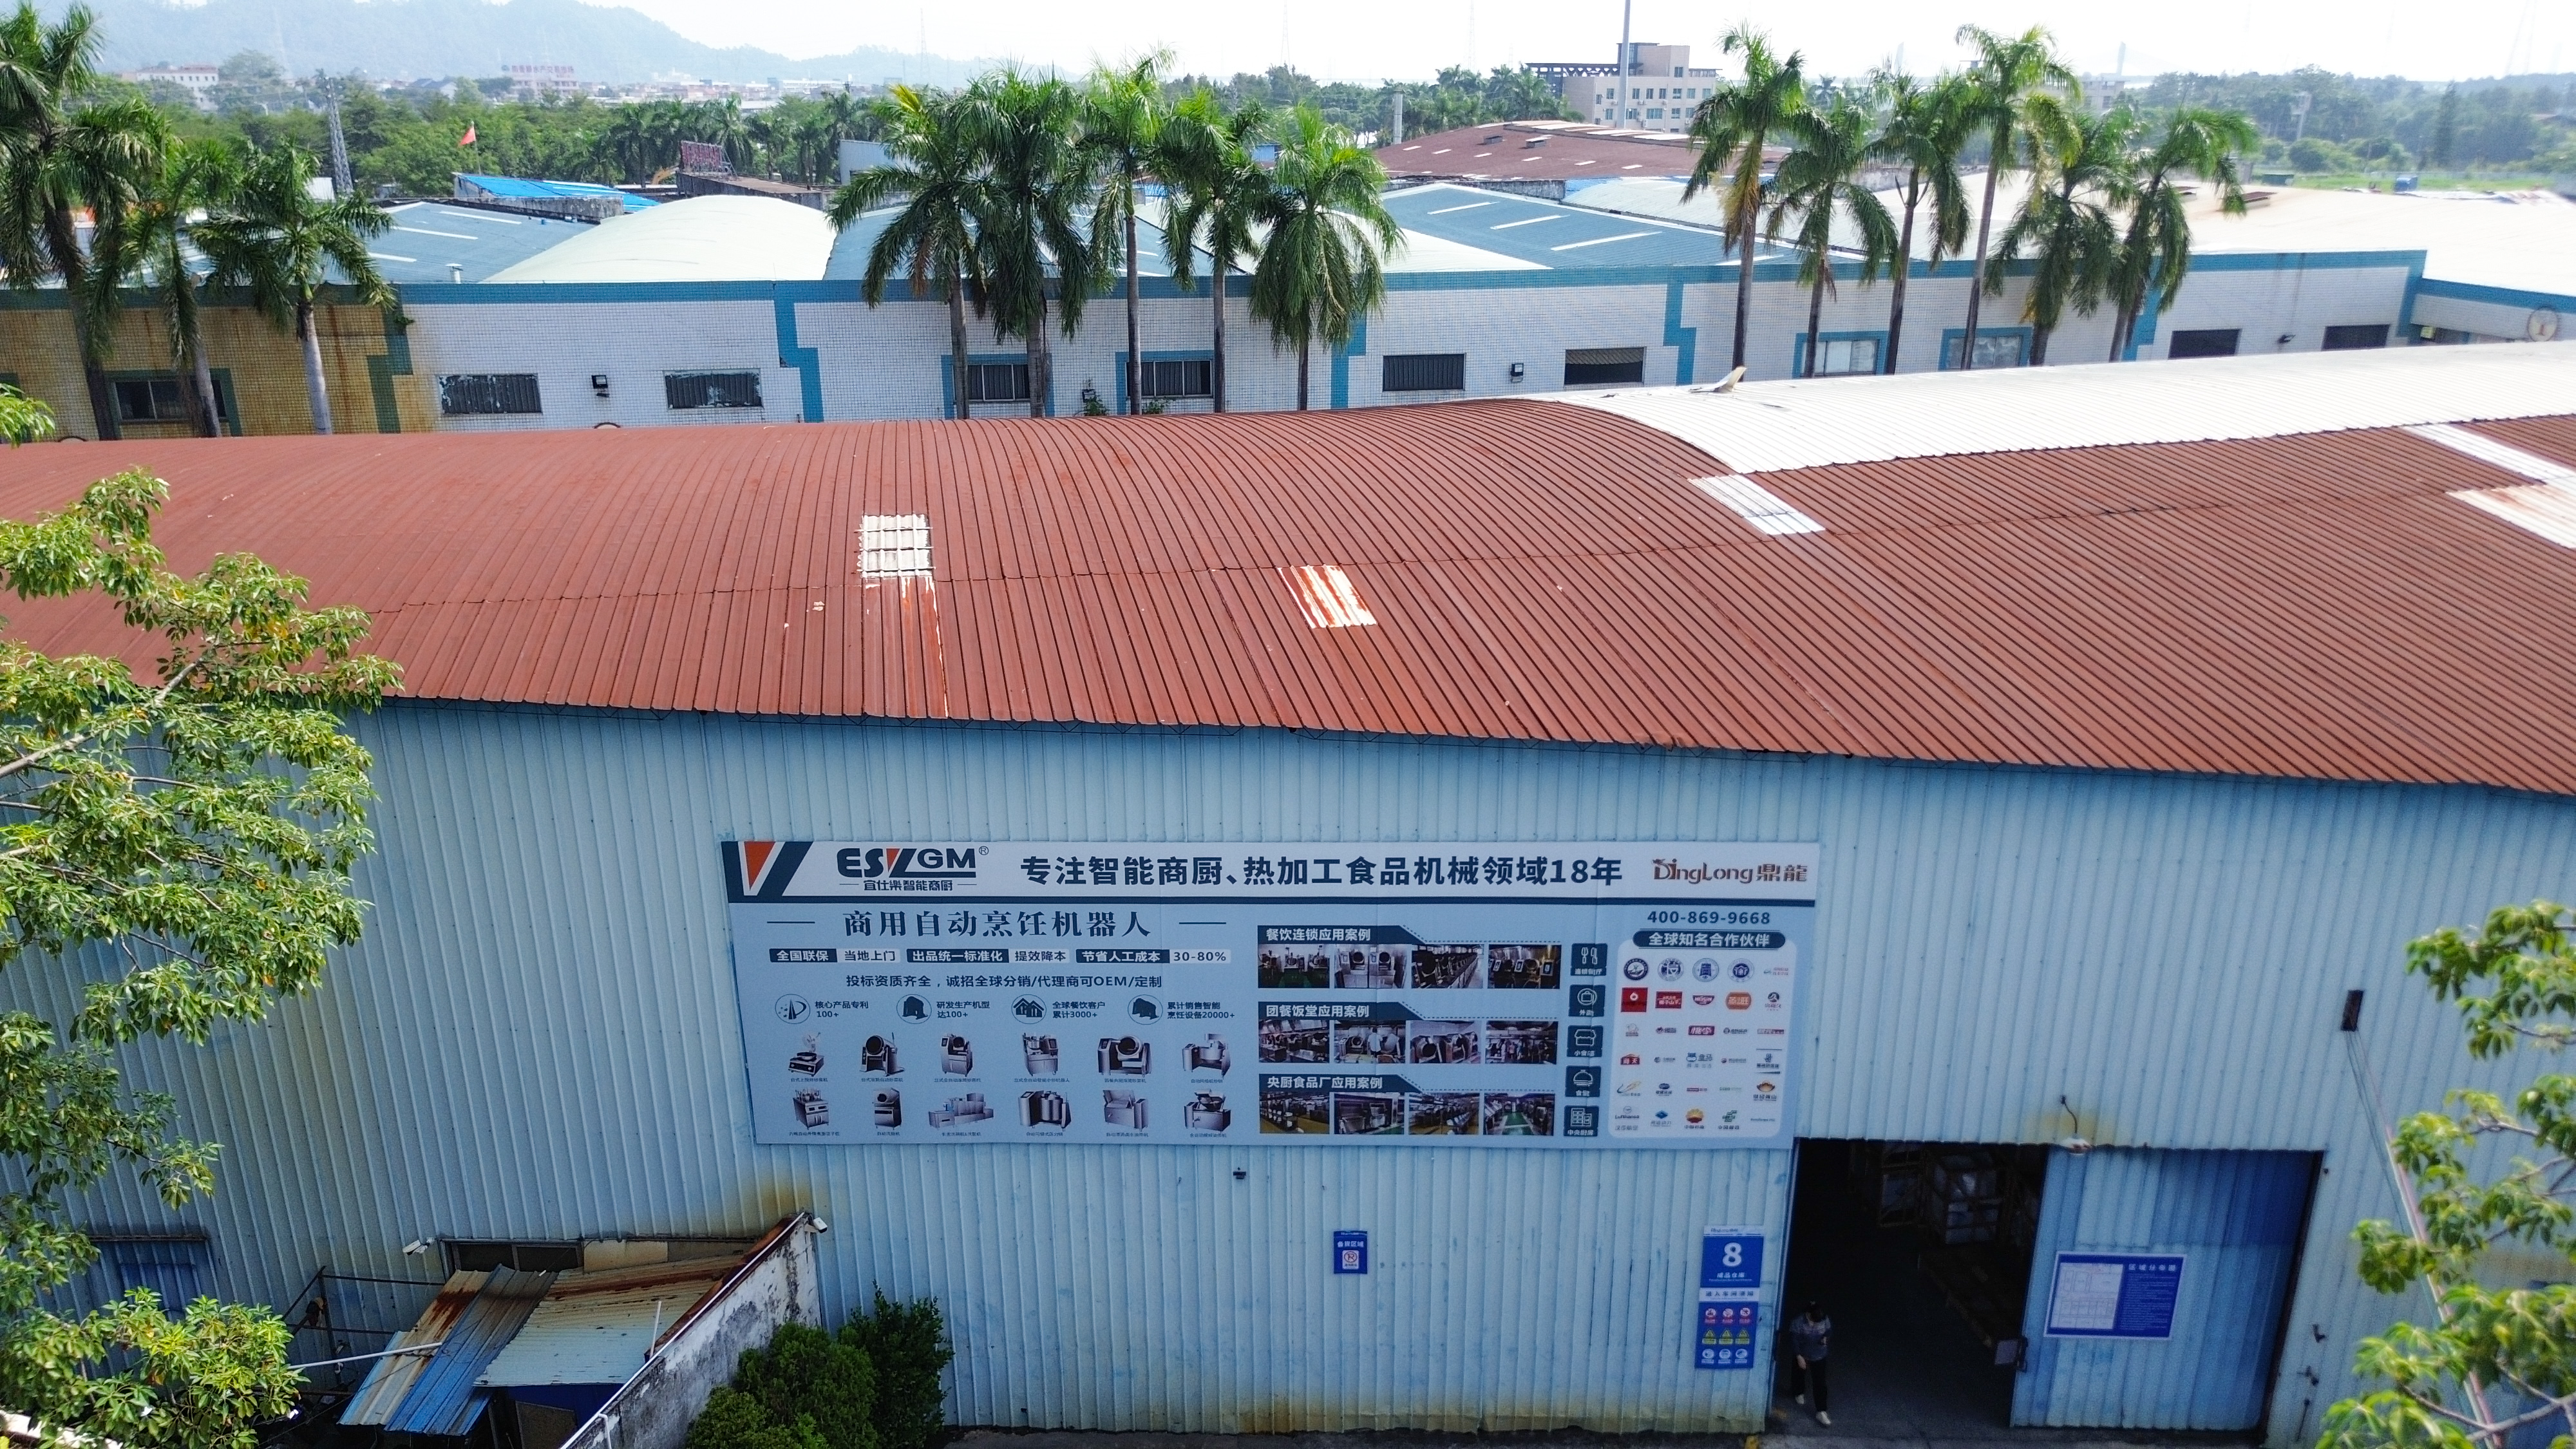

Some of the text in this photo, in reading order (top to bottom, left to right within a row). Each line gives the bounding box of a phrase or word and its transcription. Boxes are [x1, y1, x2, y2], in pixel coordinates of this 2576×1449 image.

[1021, 856, 1623, 886] 专注智能商厨、热加工食品机械领域18年
[1652, 858, 1753, 884] DingLong
[1647, 911, 1770, 924] 400-869-9668
[843, 910, 1151, 937] 商用自动烹饪机器人
[1266, 928, 1371, 941] 餐饮连锁应用案例
[1648, 931, 1770, 947] 全球知名合作伙伴
[776, 950, 829, 961] 全国联保
[844, 950, 896, 961] 当地上门
[913, 951, 1003, 962] 出品统一标准化
[1014, 951, 1067, 962] 提效降本
[1081, 951, 1160, 962] 节省人工成本
[1173, 951, 1227, 961] 30-80%
[815, 1001, 869, 1009] 核心产品专利
[936, 1001, 990, 1009] 研发生产机型
[1052, 1001, 1106, 1010] 全球餐饮客户
[1168, 1001, 1221, 1010] 累计销售智能
[937, 1010, 968, 1019] 达100+
[1168, 1011, 1235, 1019] 烹饪设备20000+
[1265, 1004, 1370, 1019] 团餐饭堂应用案例
[1266, 1075, 1383, 1090] 央厨食品厂应用案例
[1722, 1242, 1742, 1267] 8
